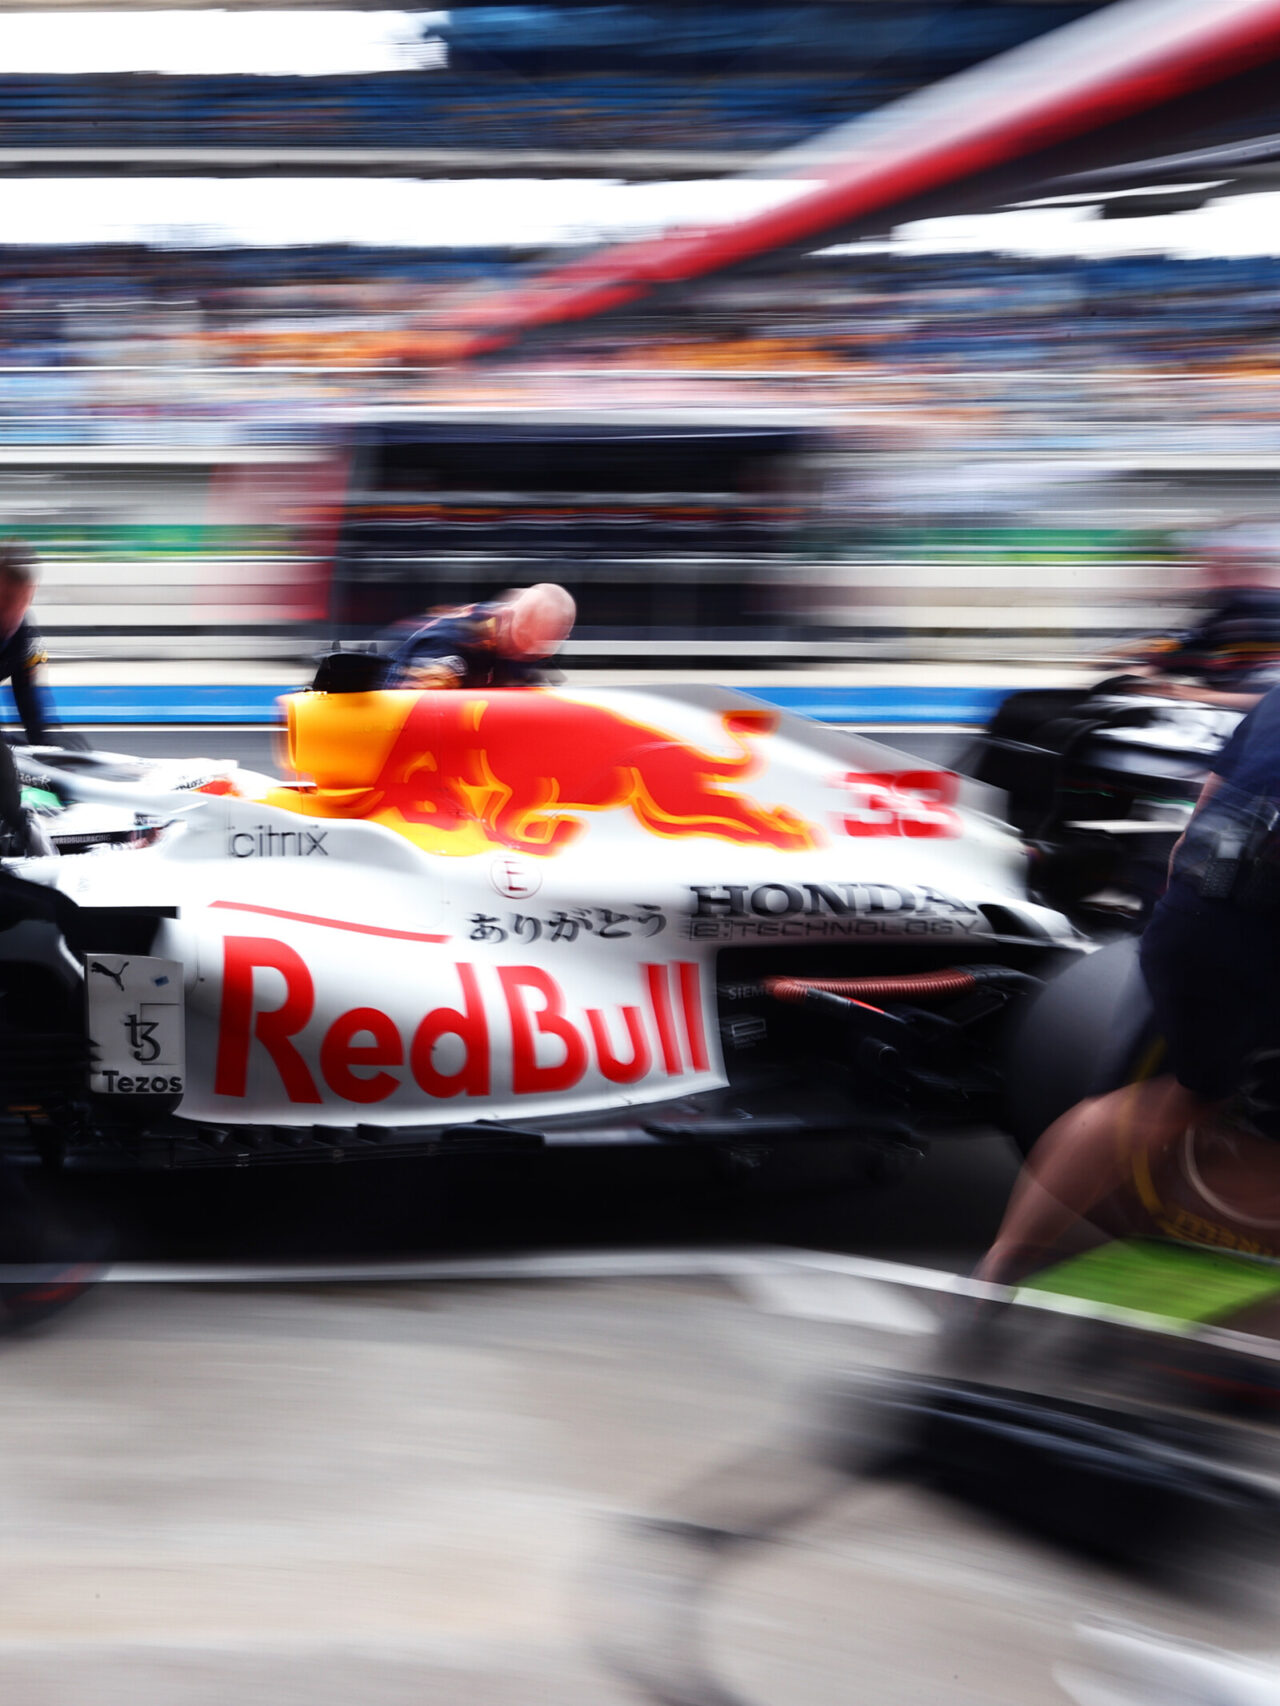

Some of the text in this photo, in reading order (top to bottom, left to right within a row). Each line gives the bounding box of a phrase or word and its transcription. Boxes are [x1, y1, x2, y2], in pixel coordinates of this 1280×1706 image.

[228, 825, 328, 858] citrix
[503, 860, 527, 892] E
[690, 883, 977, 918] HONDA
[468, 903, 667, 944] ありがとう
[102, 1070, 183, 1093] Tezos
